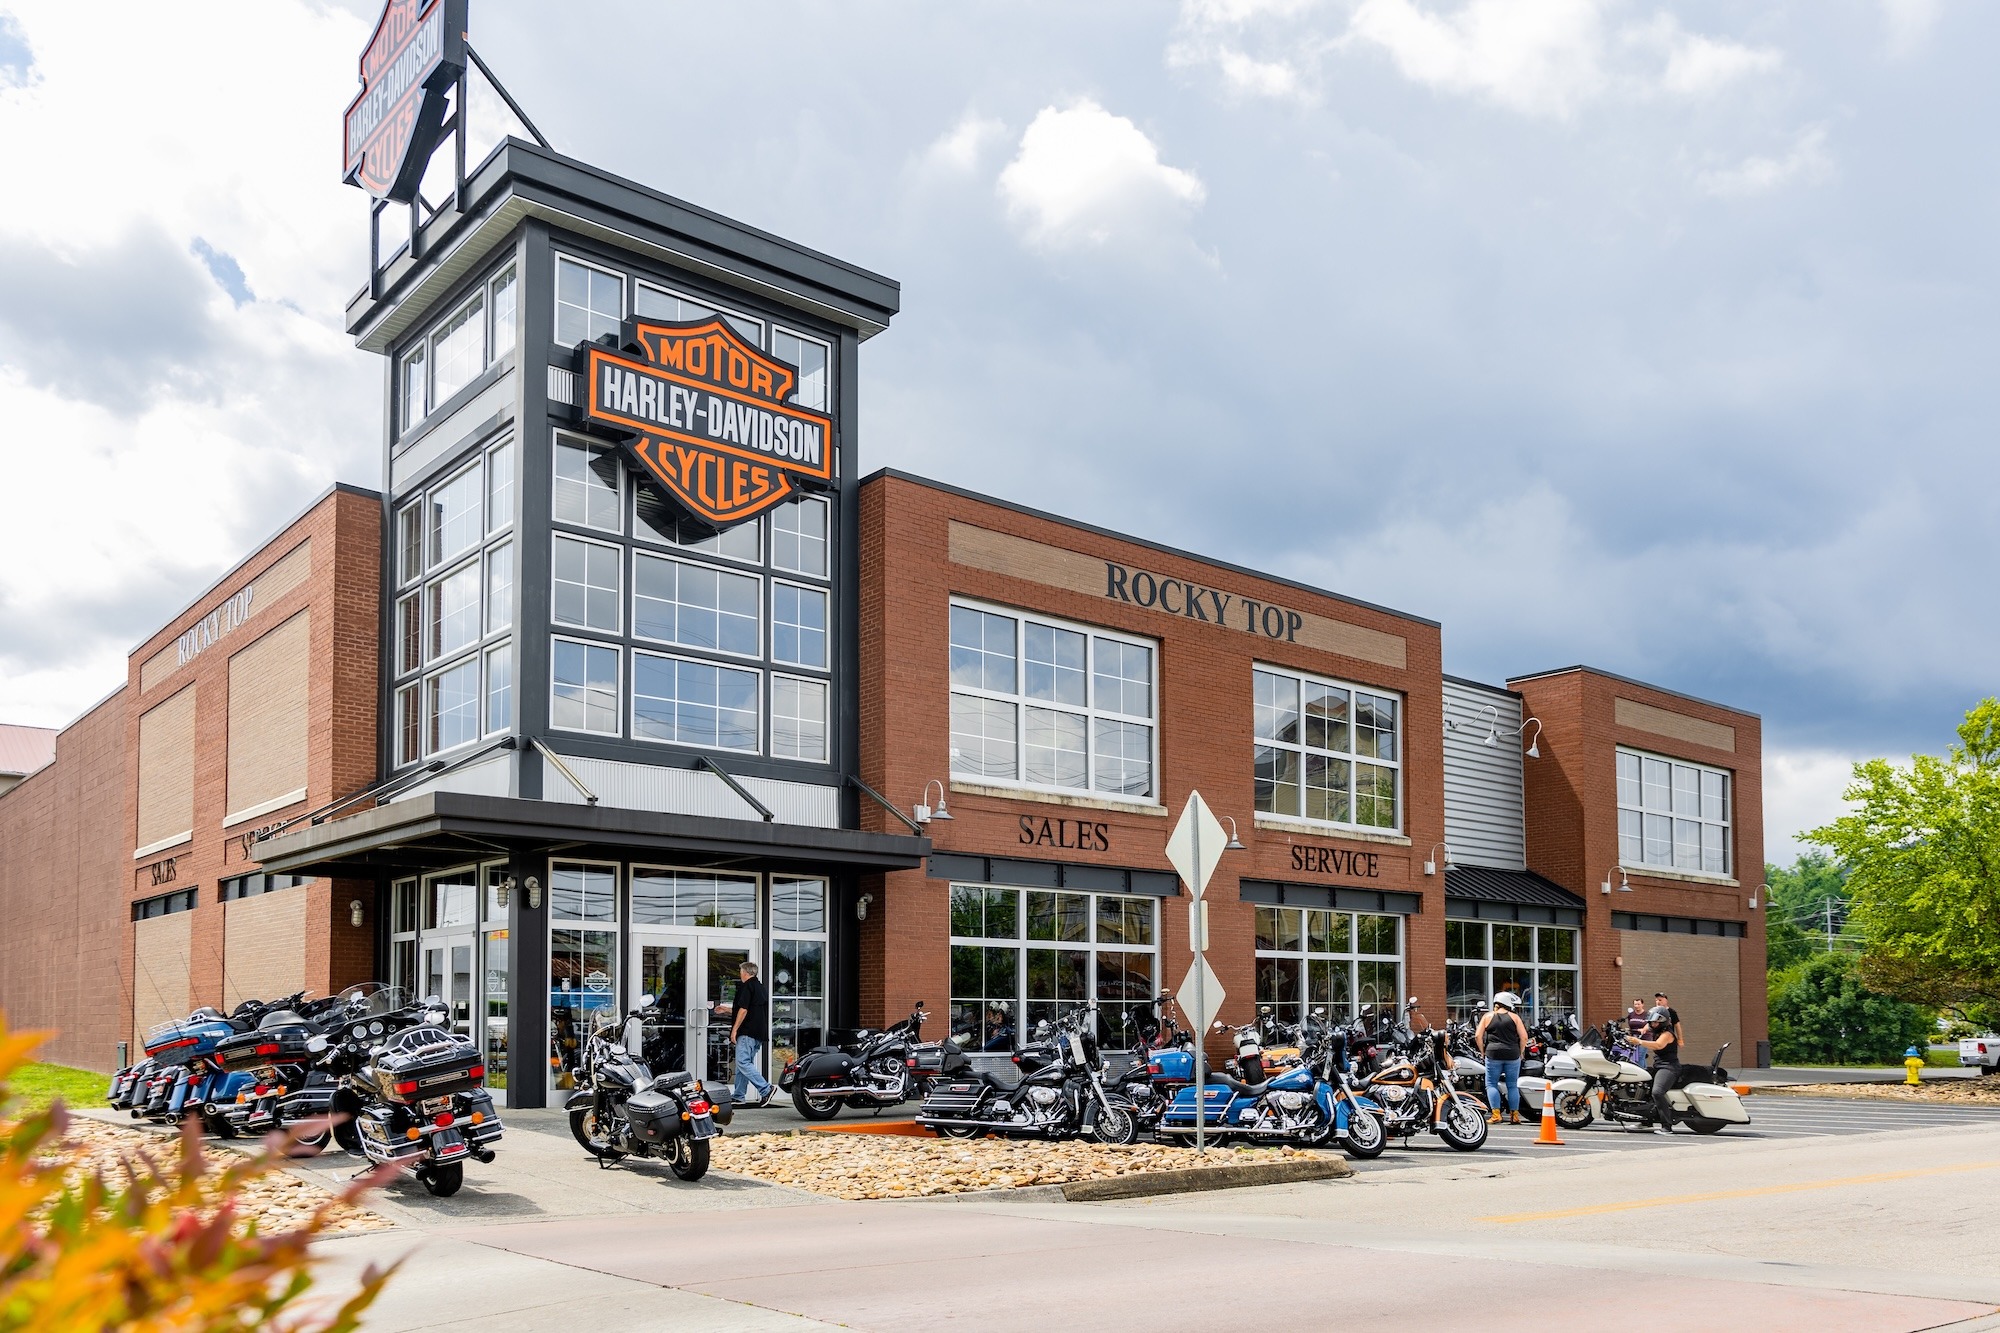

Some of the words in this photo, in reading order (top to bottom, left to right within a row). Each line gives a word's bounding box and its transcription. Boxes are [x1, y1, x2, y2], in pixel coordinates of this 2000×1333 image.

[369, 0, 417, 79] MOTOR
[350, 10, 439, 155] HARLEY-DAVIDSON
[367, 100, 414, 179] CYCLES
[659, 333, 773, 397] MOTOR
[603, 365, 820, 465] HARLEY-DAVIDSON
[658, 441, 770, 511] CYCLES
[178, 607, 222, 667] ROCKY
[225, 585, 254, 634] TOP
[1105, 562, 1232, 626] ROCKY
[1241, 598, 1303, 643] TOP
[151, 858, 177, 886] SALES
[1019, 815, 1109, 851] SALES
[1291, 845, 1380, 878] SERVICE
